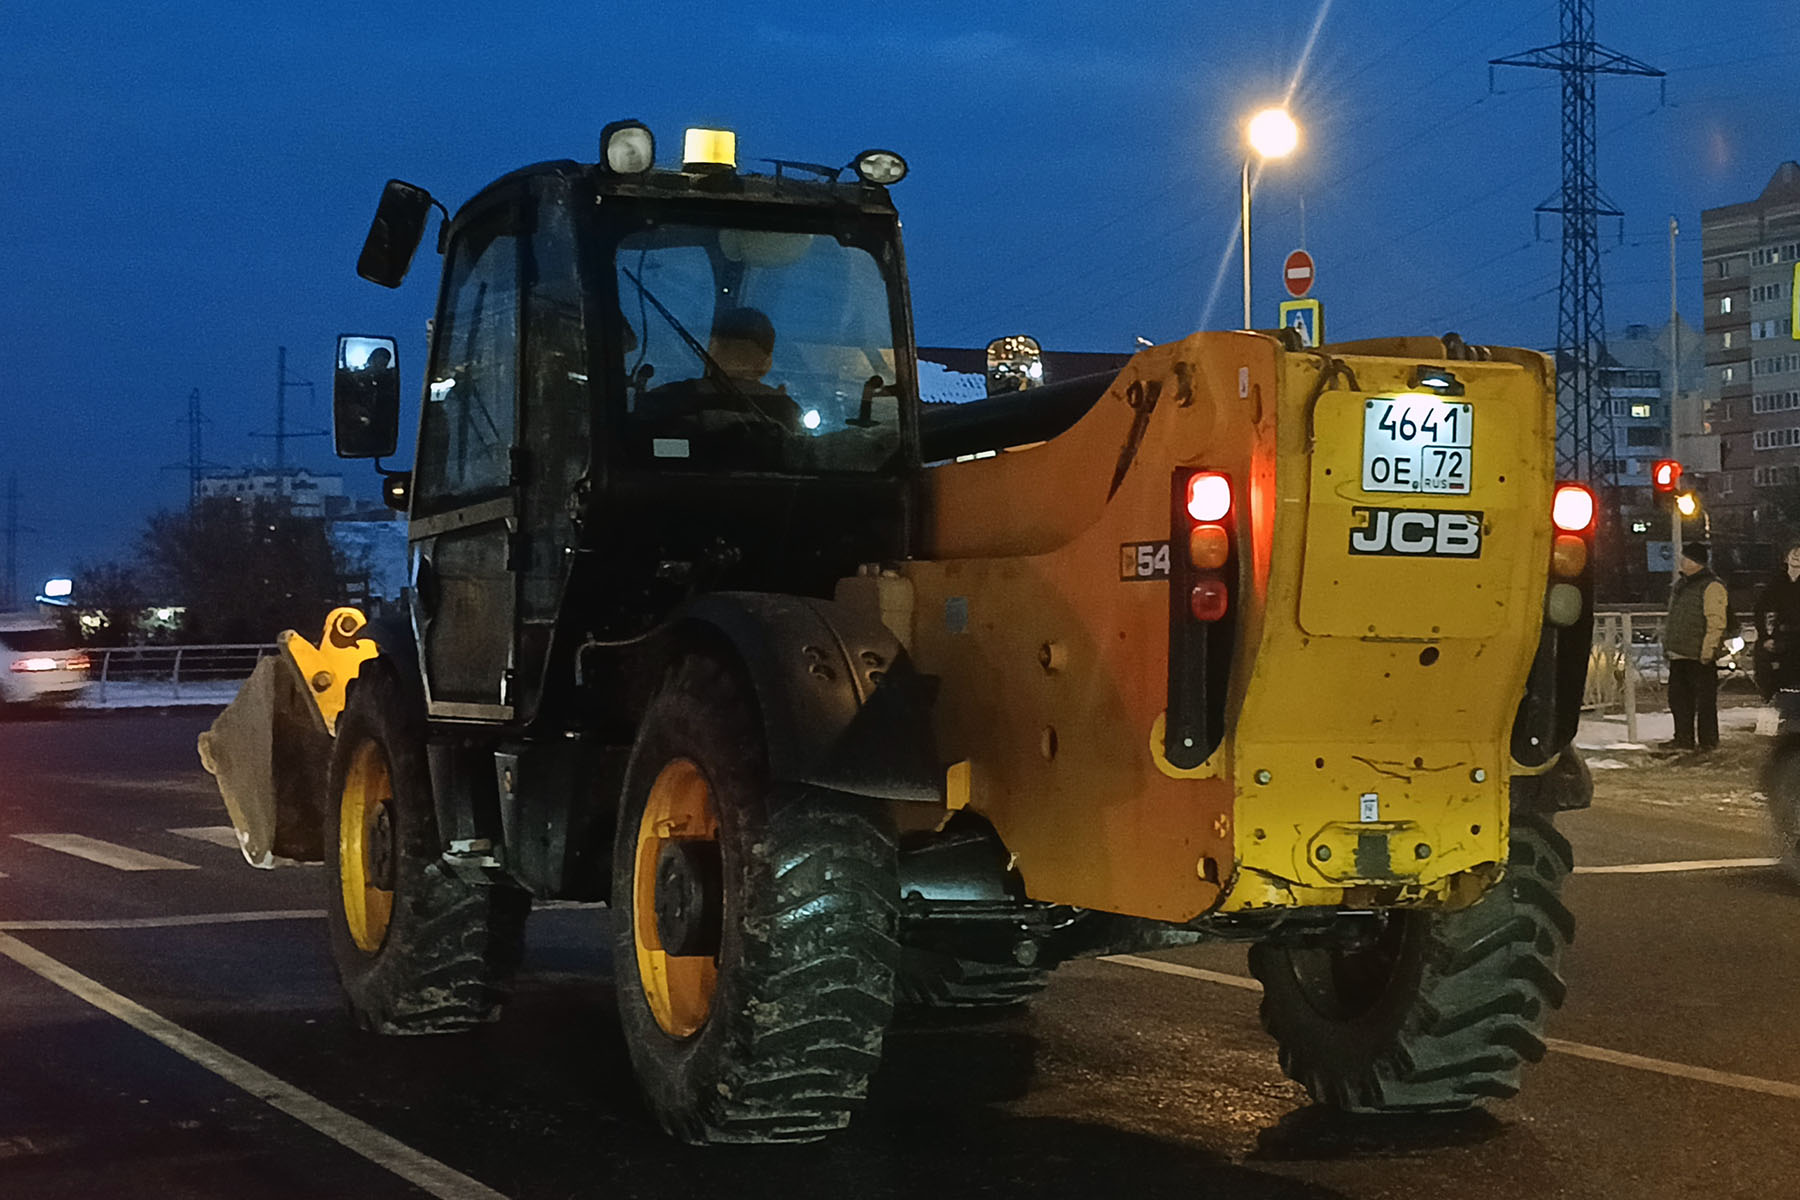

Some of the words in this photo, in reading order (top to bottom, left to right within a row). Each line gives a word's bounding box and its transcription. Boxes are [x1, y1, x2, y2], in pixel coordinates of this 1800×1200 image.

[1379, 405, 1458, 443] 4641
[1371, 457, 1411, 485] OE
[1433, 450, 1463, 478] 72
[1425, 478, 1447, 489] RUS
[1352, 511, 1480, 554] JCB
